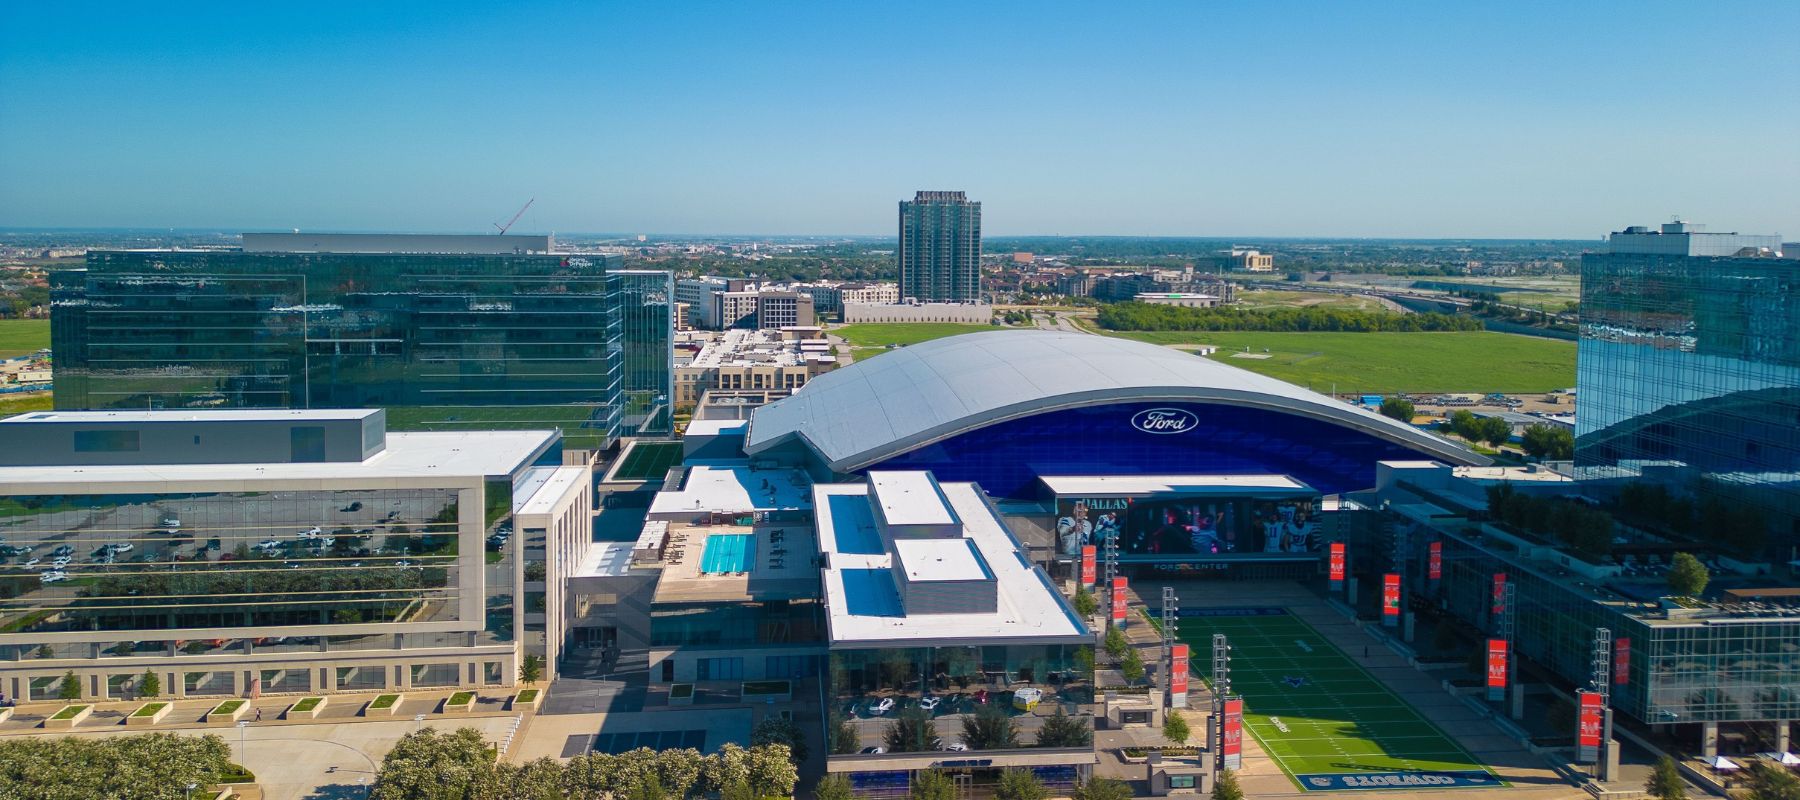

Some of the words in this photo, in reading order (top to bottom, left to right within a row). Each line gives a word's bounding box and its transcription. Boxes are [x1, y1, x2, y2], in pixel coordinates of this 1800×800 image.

[1143, 411, 1187, 430] Ford
[1082, 498, 1128, 510] DALLAS
[1342, 774, 1456, 787] COWBOYS
